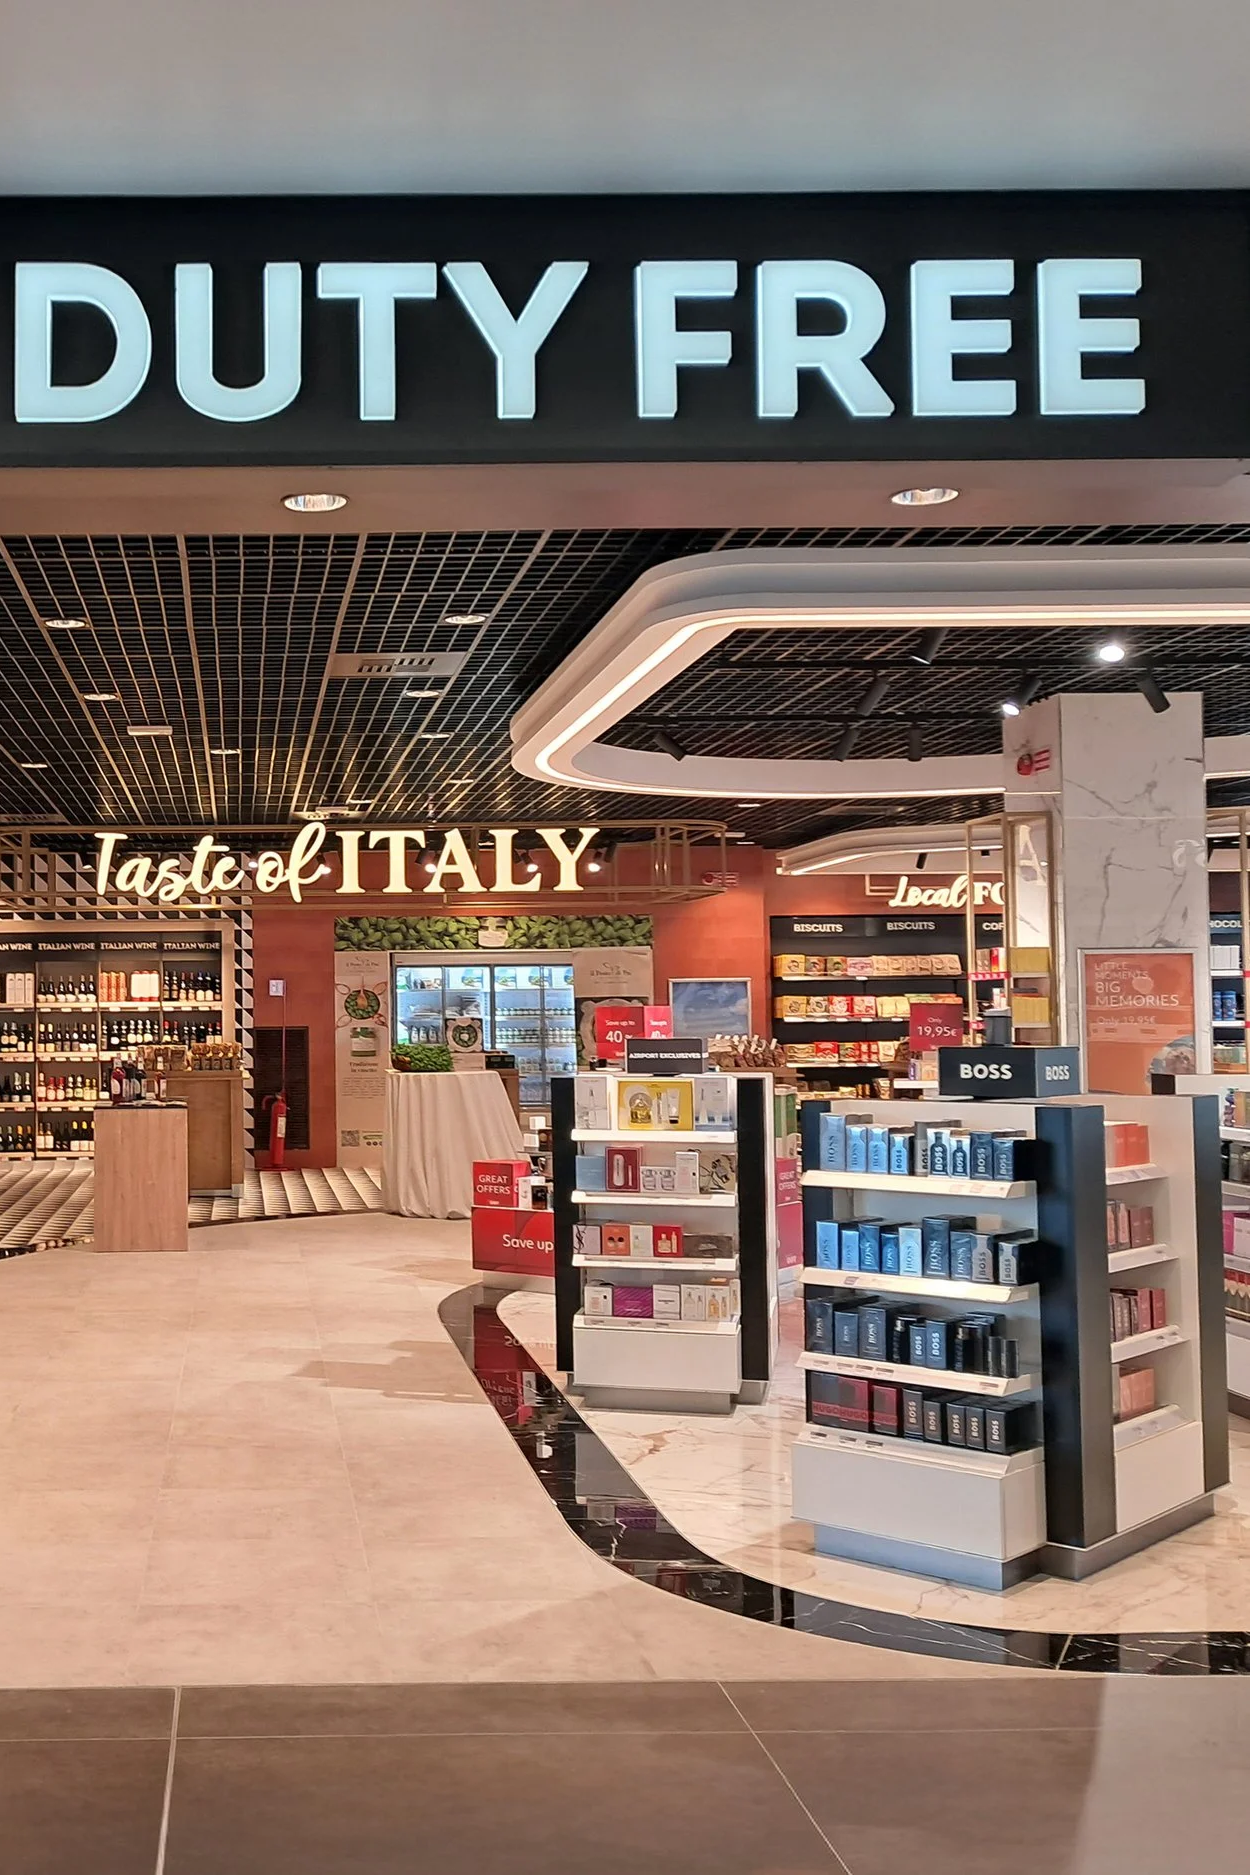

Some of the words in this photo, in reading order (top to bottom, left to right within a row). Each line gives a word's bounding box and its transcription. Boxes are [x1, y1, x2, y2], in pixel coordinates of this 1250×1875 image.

[14, 259, 589, 424] DUTY
[636, 258, 1147, 420] FREE
[94, 832, 245, 901] Taste
[256, 822, 328, 903] of
[335, 827, 600, 894] ITALY
[888, 875, 969, 908] Local
[973, 881, 1005, 906] FO
[793, 923, 844, 933] BISCUITS
[886, 921, 935, 931] BISCUITS
[982, 922, 1006, 931] COF
[10, 942, 33, 951] WINE
[38, 942, 72, 951] ITALIAN
[73, 942, 95, 951] WINE
[100, 942, 134, 951] ITALIAN
[135, 942, 157, 951] WINE
[163, 942, 197, 951] ITALIAN
[198, 942, 220, 951] WINE
[1094, 962, 1127, 971] LITTLE
[1095, 970, 1149, 980] MOMENTS
[1095, 981, 1121, 993] BIG
[1095, 994, 1179, 1007] MEMORIES
[927, 1017, 942, 1025] Only
[917, 1025, 957, 1037] 19,95€
[960, 1064, 1012, 1079] BOSS
[1045, 1066, 1070, 1081] BOSS
[934, 1146, 943, 1171] BOSS
[956, 1152, 964, 1173] BOSS
[977, 1148, 986, 1174] BOSS
[478, 1174, 508, 1184] GREAT
[476, 1184, 510, 1194] OFFERS
[502, 1234, 534, 1249] Save
[537, 1241, 554, 1253] up
[932, 1332, 940, 1356] BOSS
[813, 1404, 839, 1416] HUGO
[908, 1401, 916, 1424] BOSS
